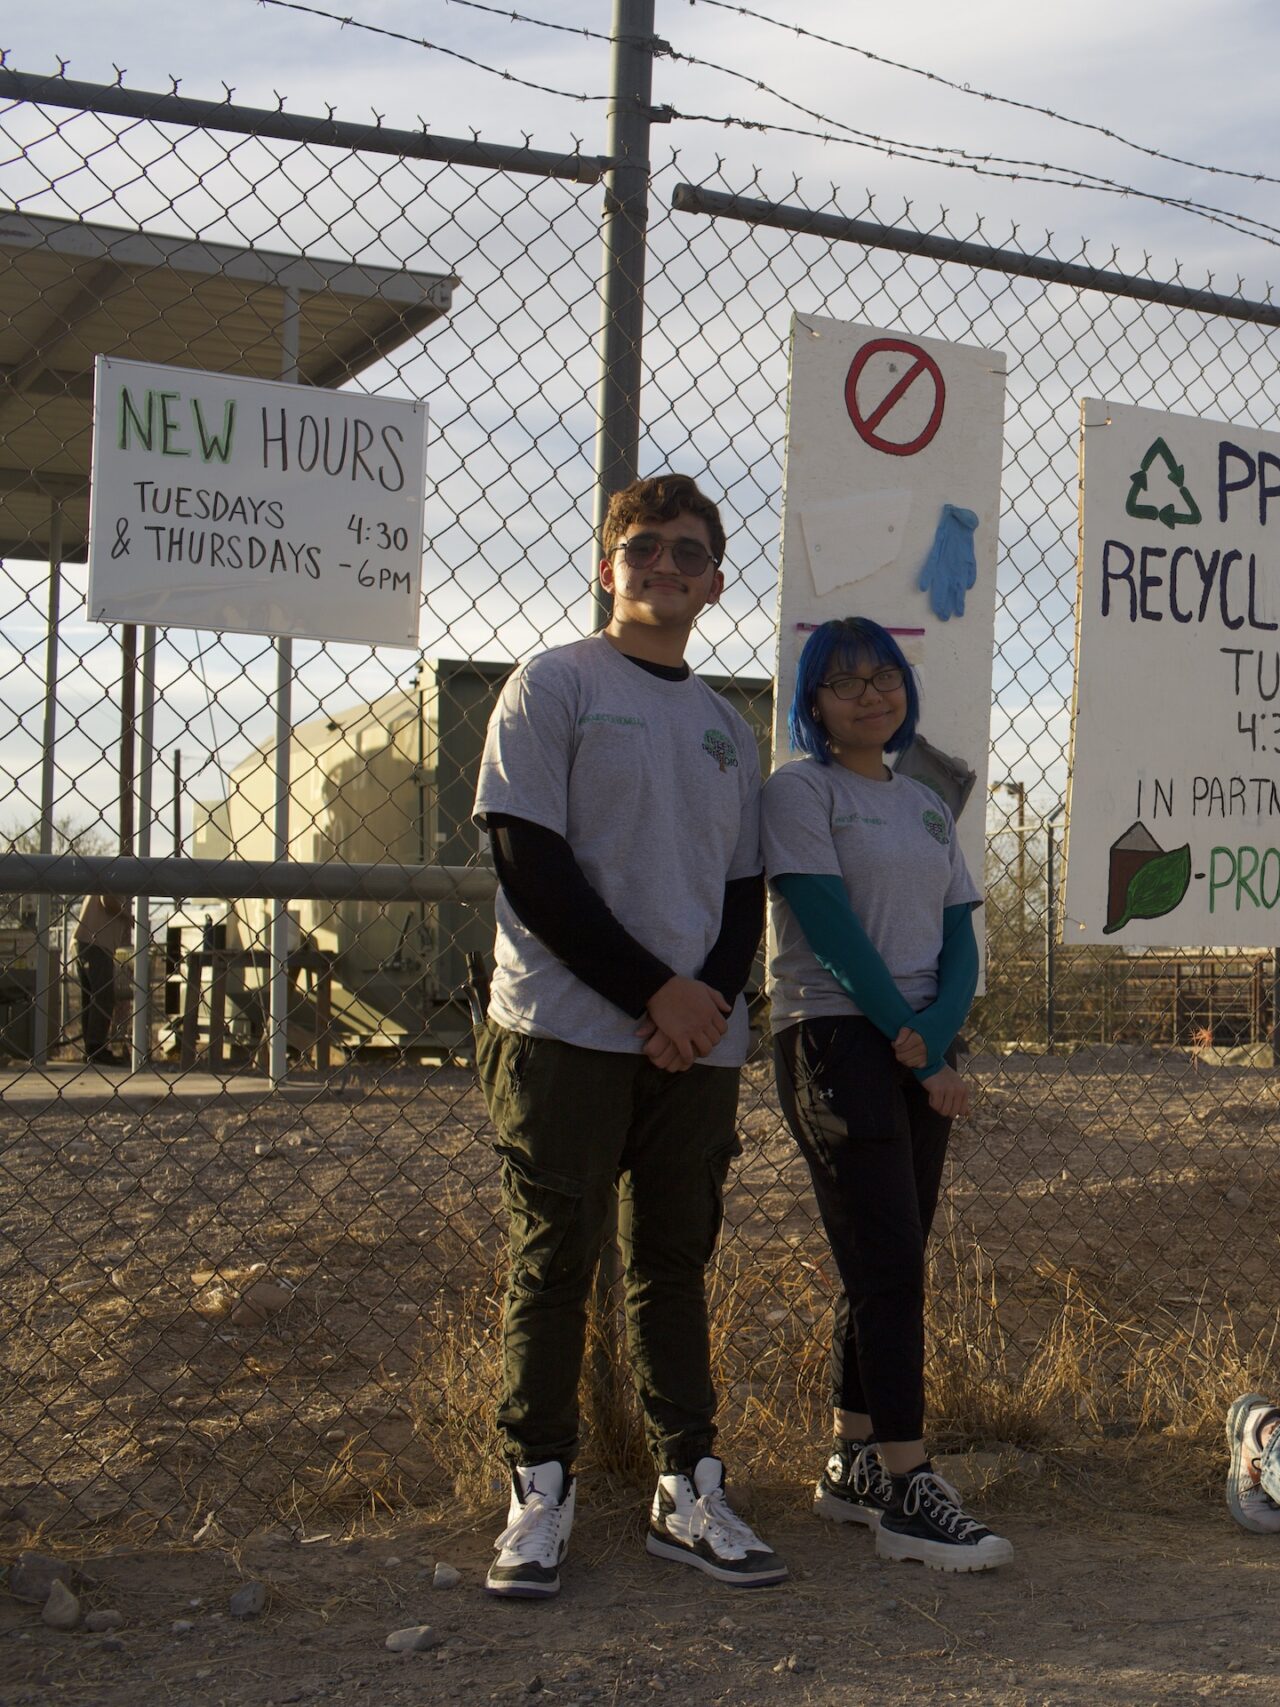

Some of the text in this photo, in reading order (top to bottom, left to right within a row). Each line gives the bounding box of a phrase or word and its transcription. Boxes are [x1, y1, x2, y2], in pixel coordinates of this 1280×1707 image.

[118, 386, 405, 492] NEW HOURS
[134, 481, 285, 529] TUESDAYS
[111, 517, 321, 579] & THURSDAYS
[347, 514, 408, 551] 4:30
[1136, 778, 1173, 819] IN
